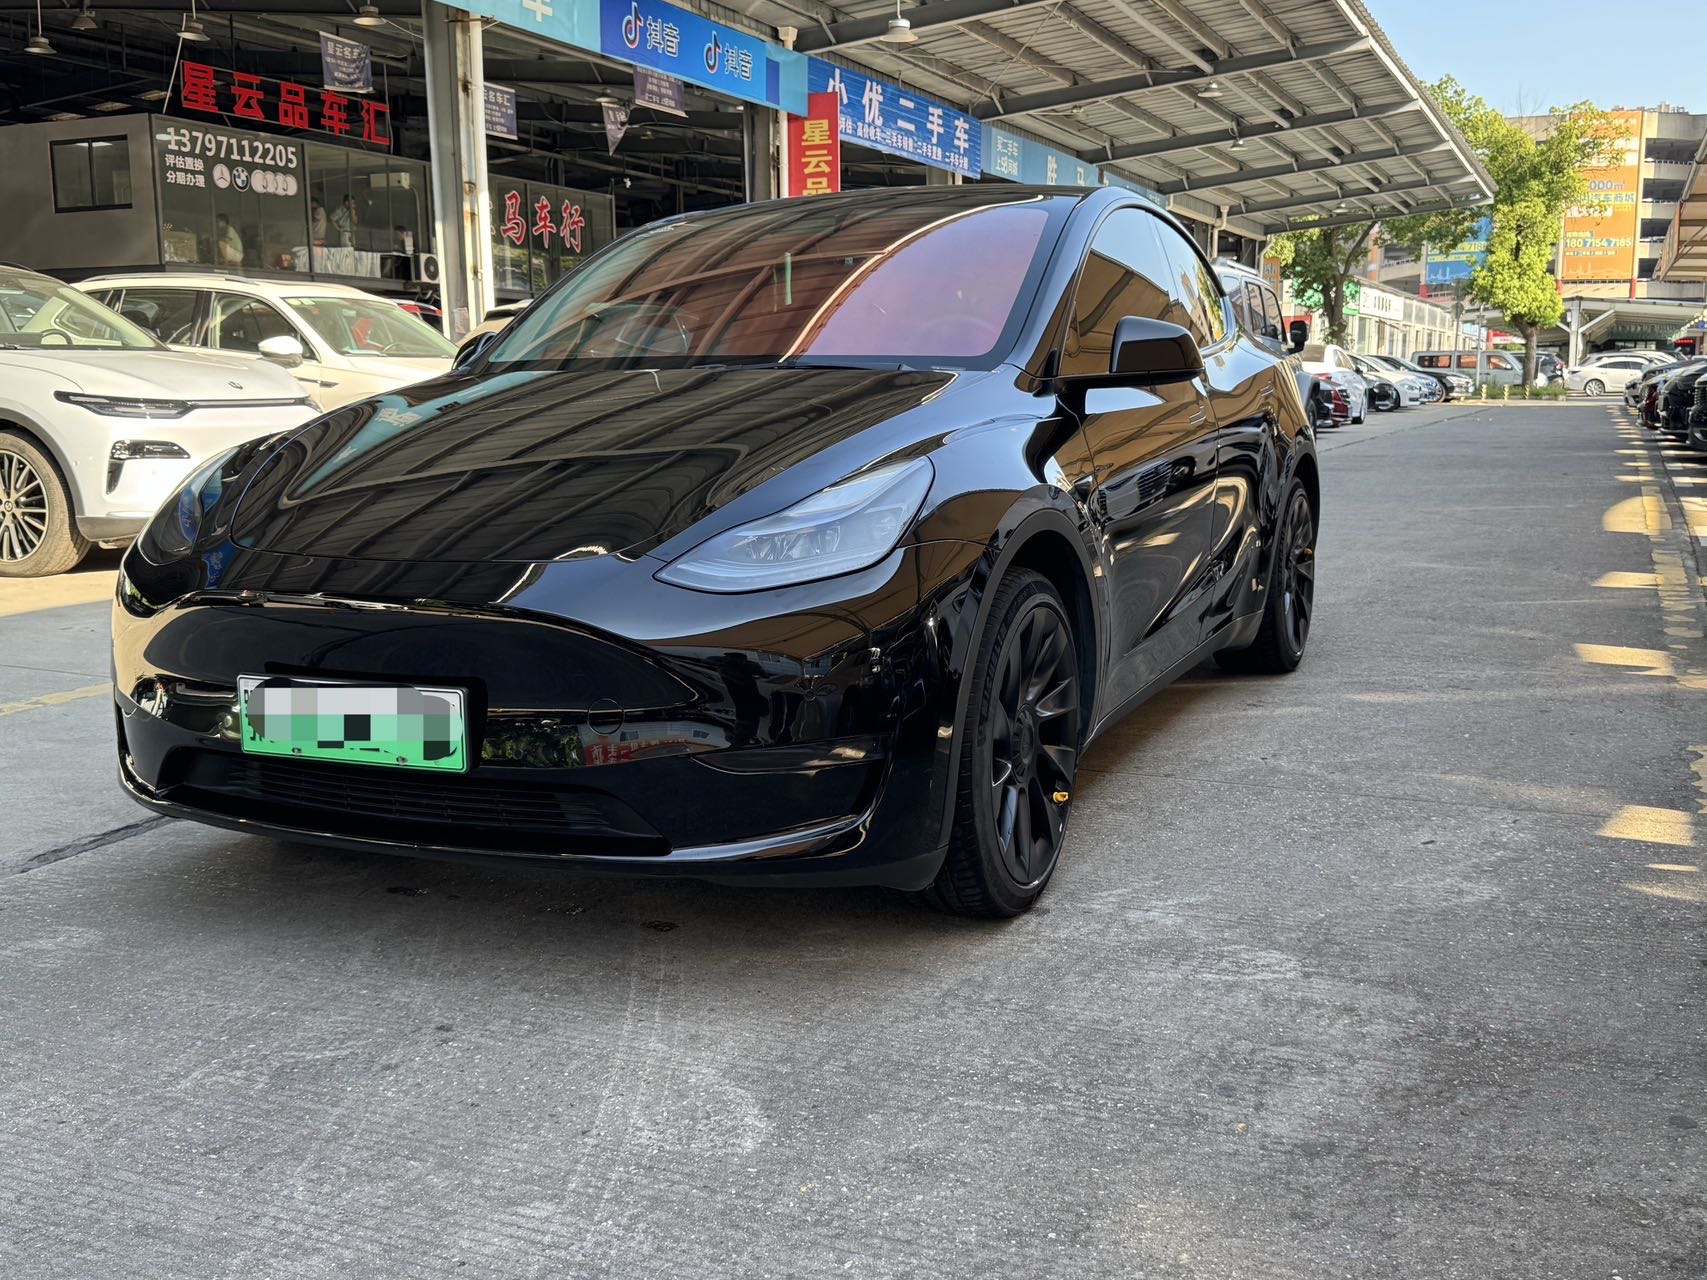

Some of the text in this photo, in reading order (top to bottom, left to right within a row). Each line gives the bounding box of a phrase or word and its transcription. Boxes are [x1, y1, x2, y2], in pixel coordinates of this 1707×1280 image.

[646, 16, 680, 58] 抖音
[723, 43, 753, 81] 抖音
[183, 61, 389, 145] 星云品车汇
[827, 68, 970, 154] 小优二手车
[165, 153, 205, 171] 评估置换
[166, 127, 298, 169] 13797112205
[801, 119, 833, 196] 星云品
[166, 170, 206, 188] 分期办理
[489, 190, 585, 253] 马车行
